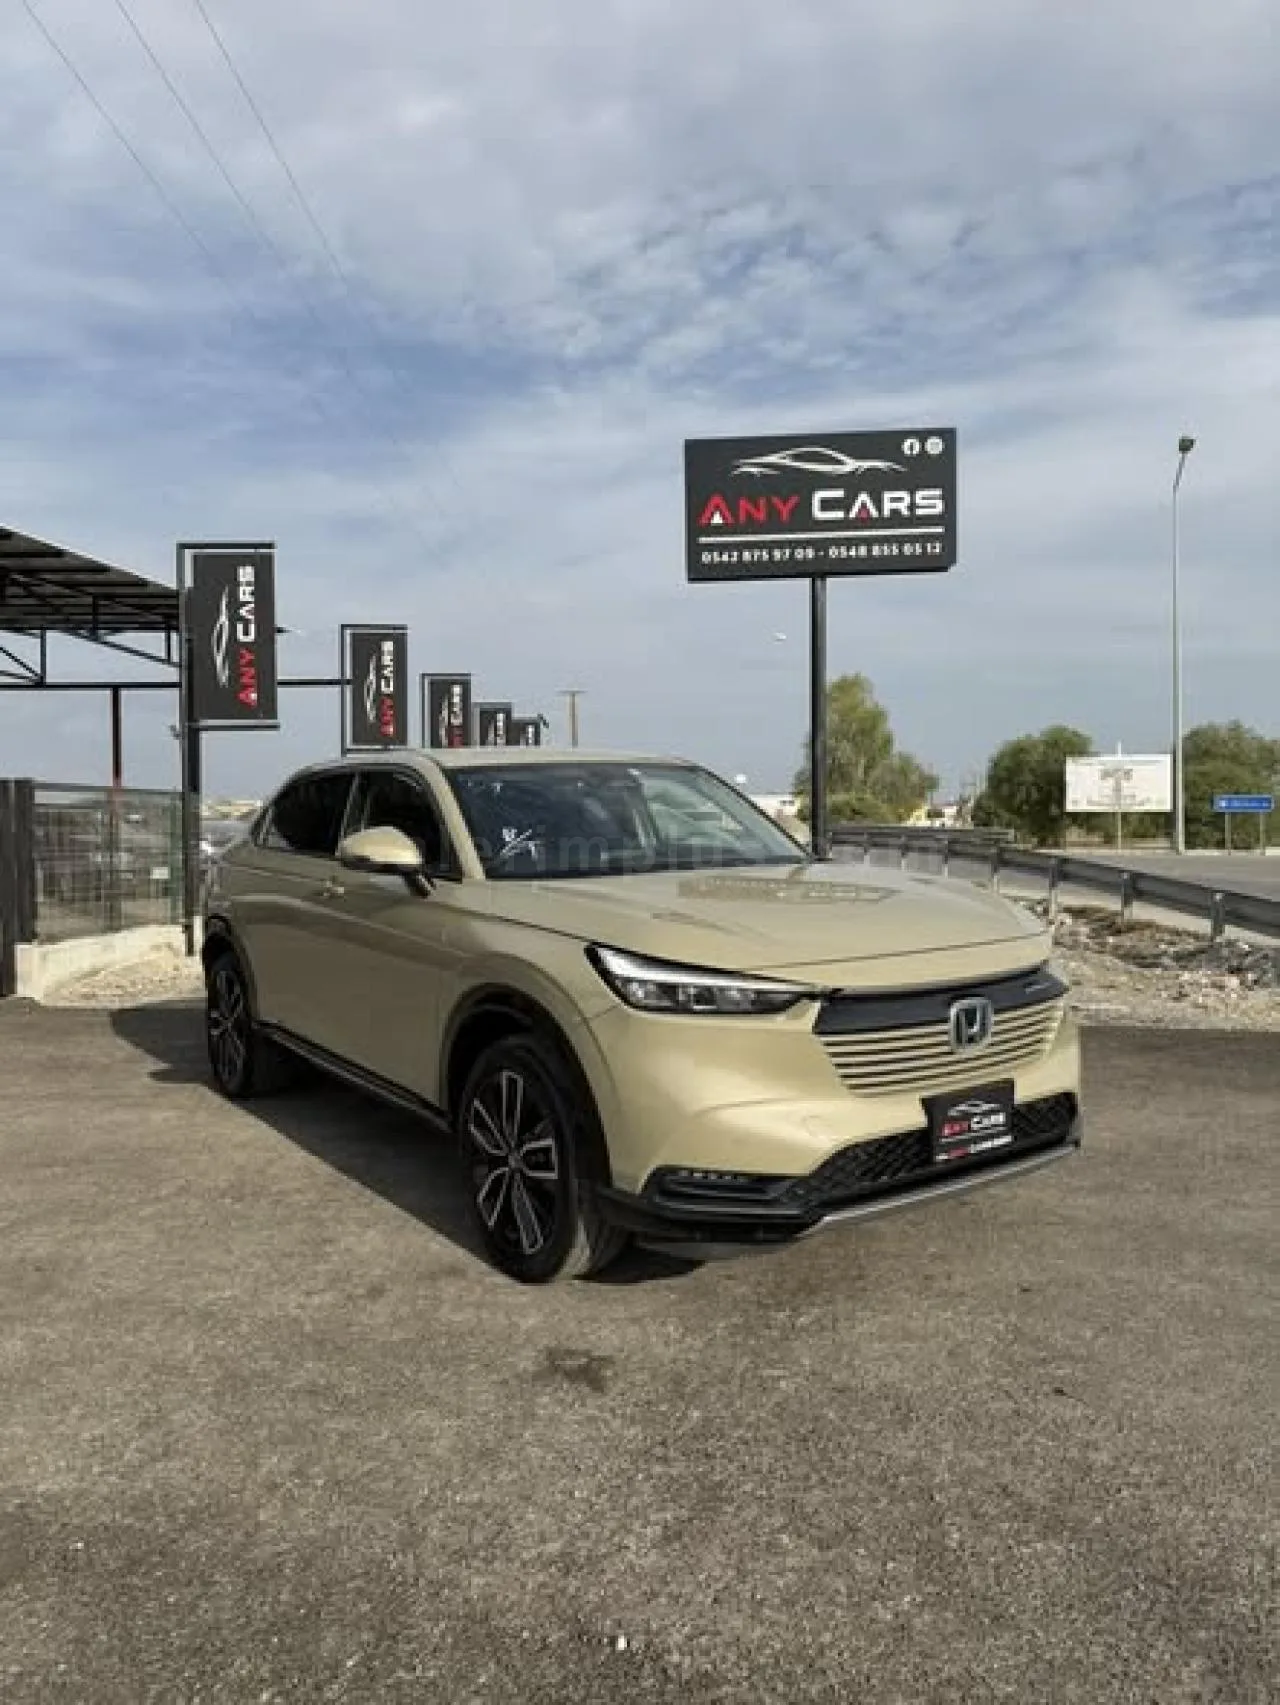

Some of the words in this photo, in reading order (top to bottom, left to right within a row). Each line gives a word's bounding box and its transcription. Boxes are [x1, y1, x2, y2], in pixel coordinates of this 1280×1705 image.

[698, 493, 800, 528] ANY
[812, 487, 944, 521] CARS
[236, 565, 255, 643] CARS
[235, 646, 257, 709] ANY
